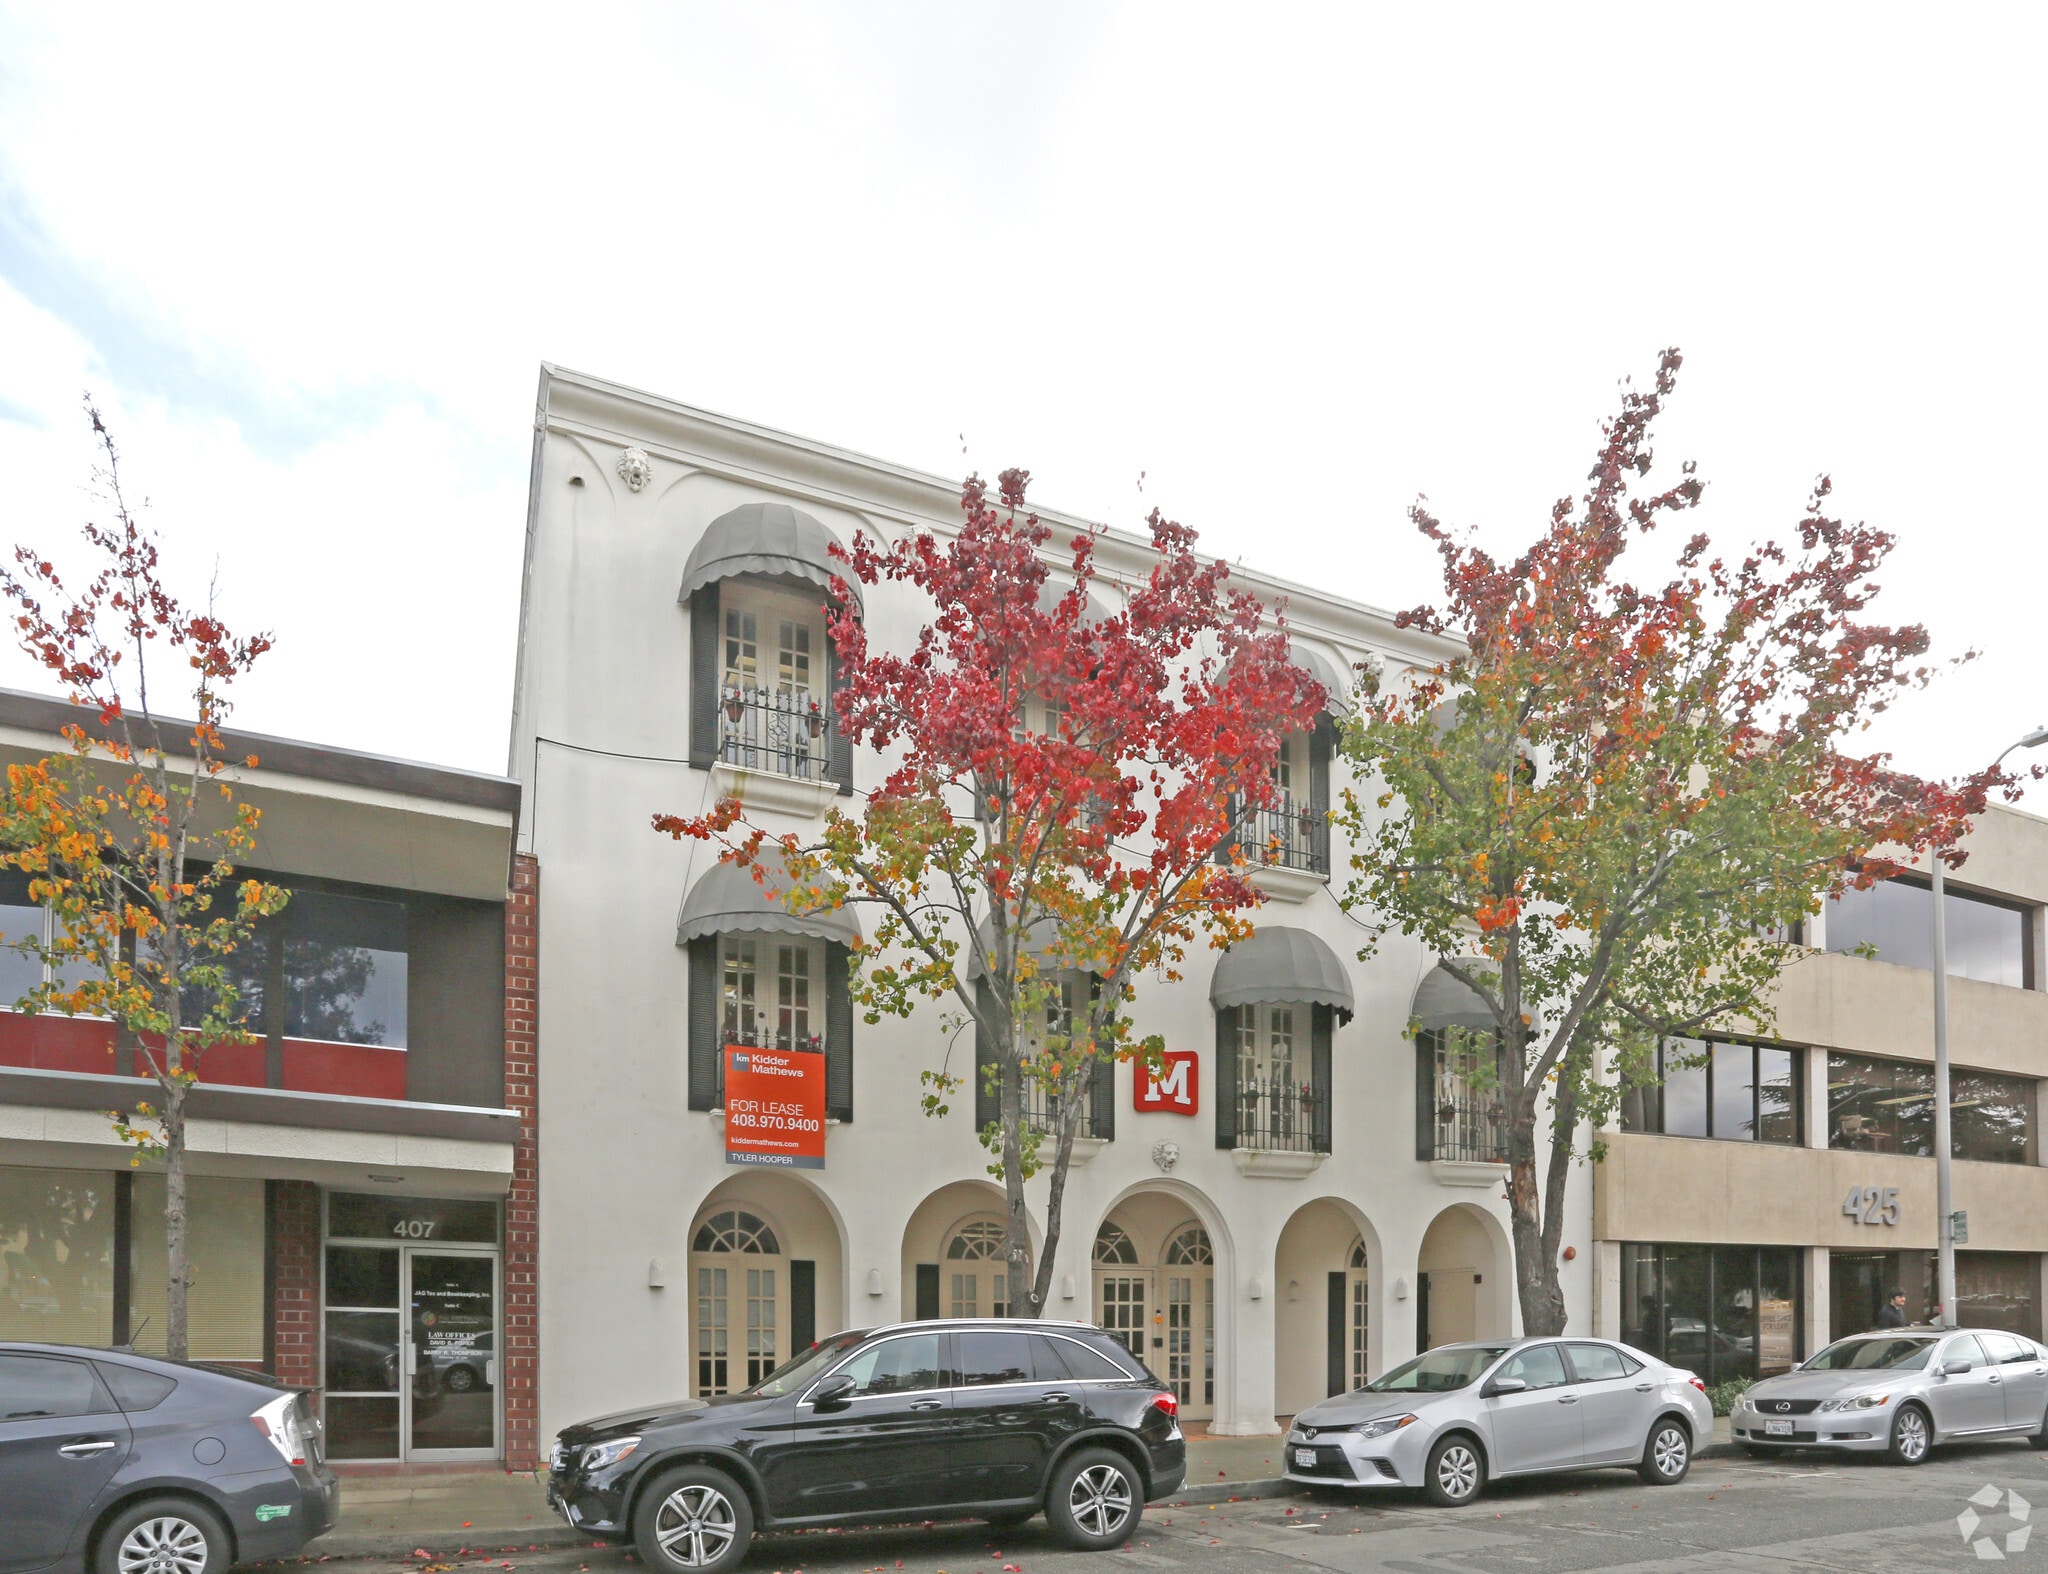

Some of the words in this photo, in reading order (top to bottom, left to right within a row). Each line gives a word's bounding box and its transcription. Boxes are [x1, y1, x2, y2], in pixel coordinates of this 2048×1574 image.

[752, 1054, 789, 1066] Kidder
[752, 1064, 804, 1078] Mathews
[1144, 1056, 1191, 1105] M
[730, 1099, 759, 1113] FOR
[762, 1102, 804, 1117] LEASE
[731, 1113, 819, 1132] 408.970.9400
[731, 1136, 799, 1149] kiddermathews.com
[731, 1153, 757, 1163] TYLER
[758, 1155, 793, 1165] HOOPER
[1843, 1185, 1901, 1226] 425
[393, 1220, 435, 1238] 407
